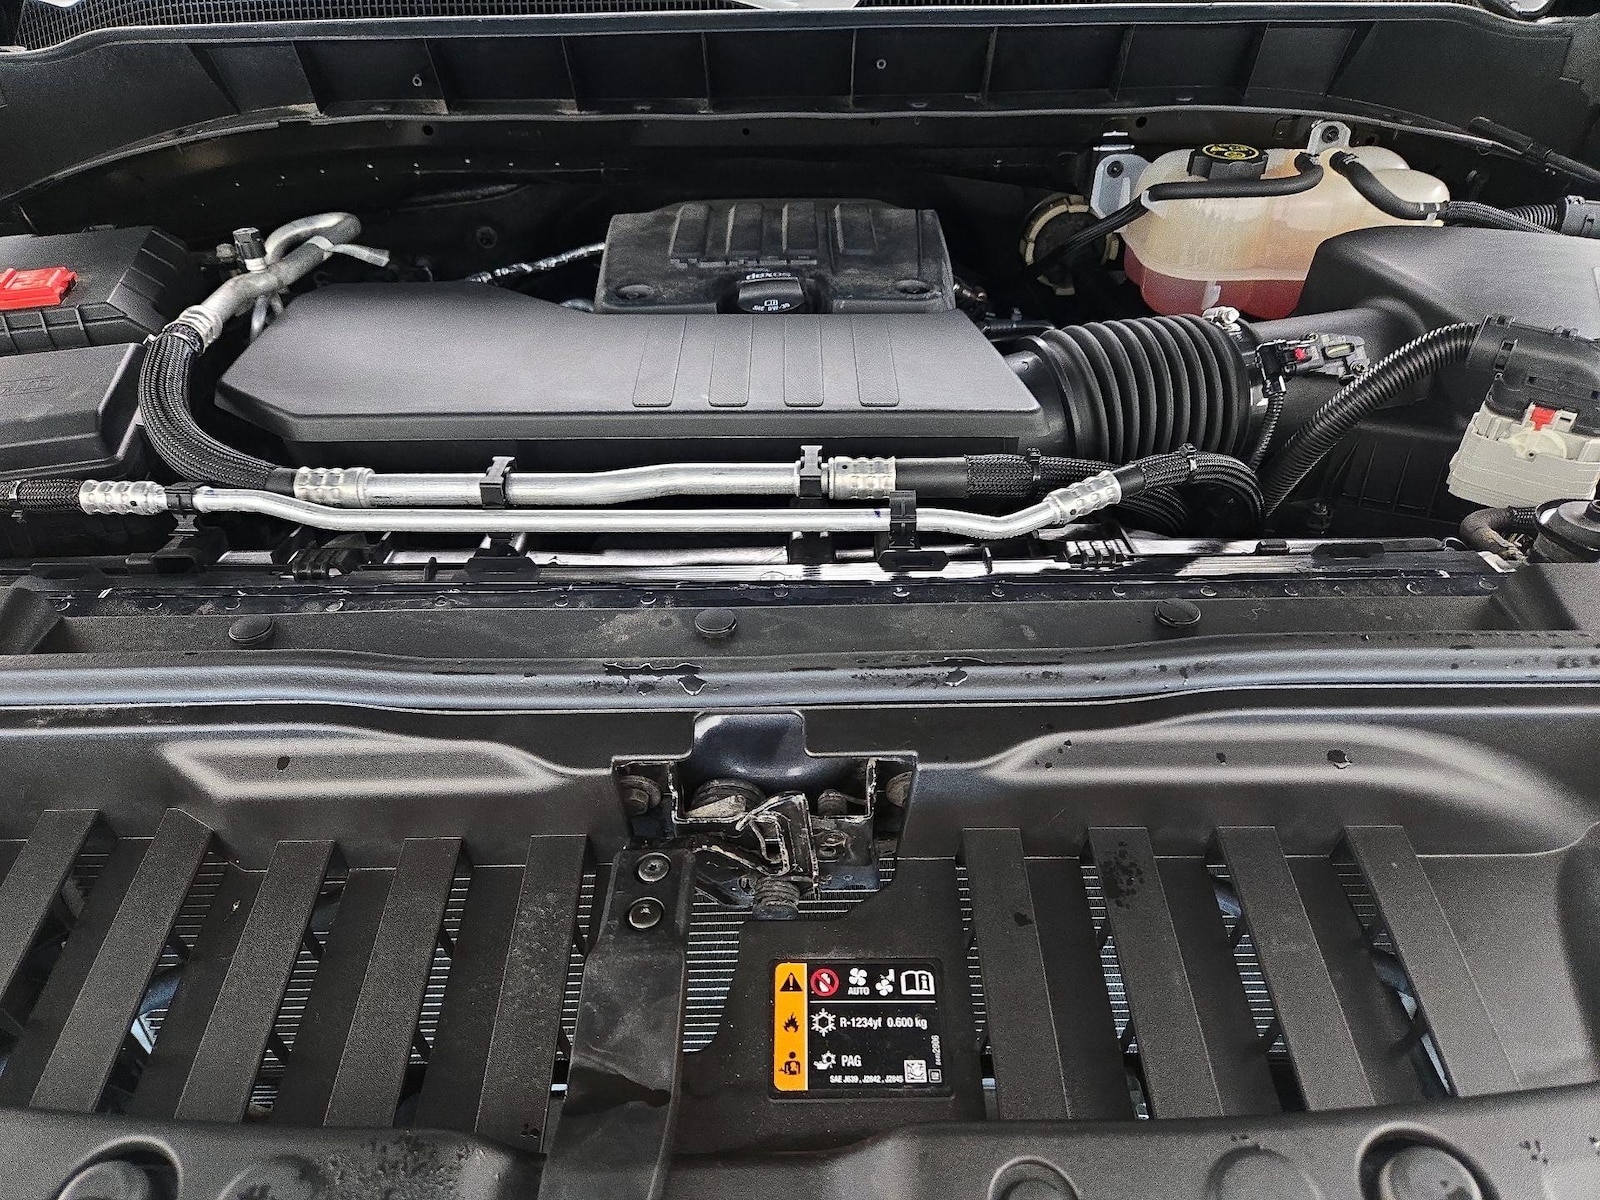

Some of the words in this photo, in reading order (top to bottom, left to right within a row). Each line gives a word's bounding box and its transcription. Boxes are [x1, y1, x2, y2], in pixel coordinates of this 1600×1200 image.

[848, 987, 870, 996] AUTO
[839, 1018, 882, 1030] R-1234yf
[886, 1018, 914, 1028] 0.600
[915, 1018, 928, 1030] kg
[841, 1055, 862, 1067] PAG
[829, 1075, 843, 1083] SAE
